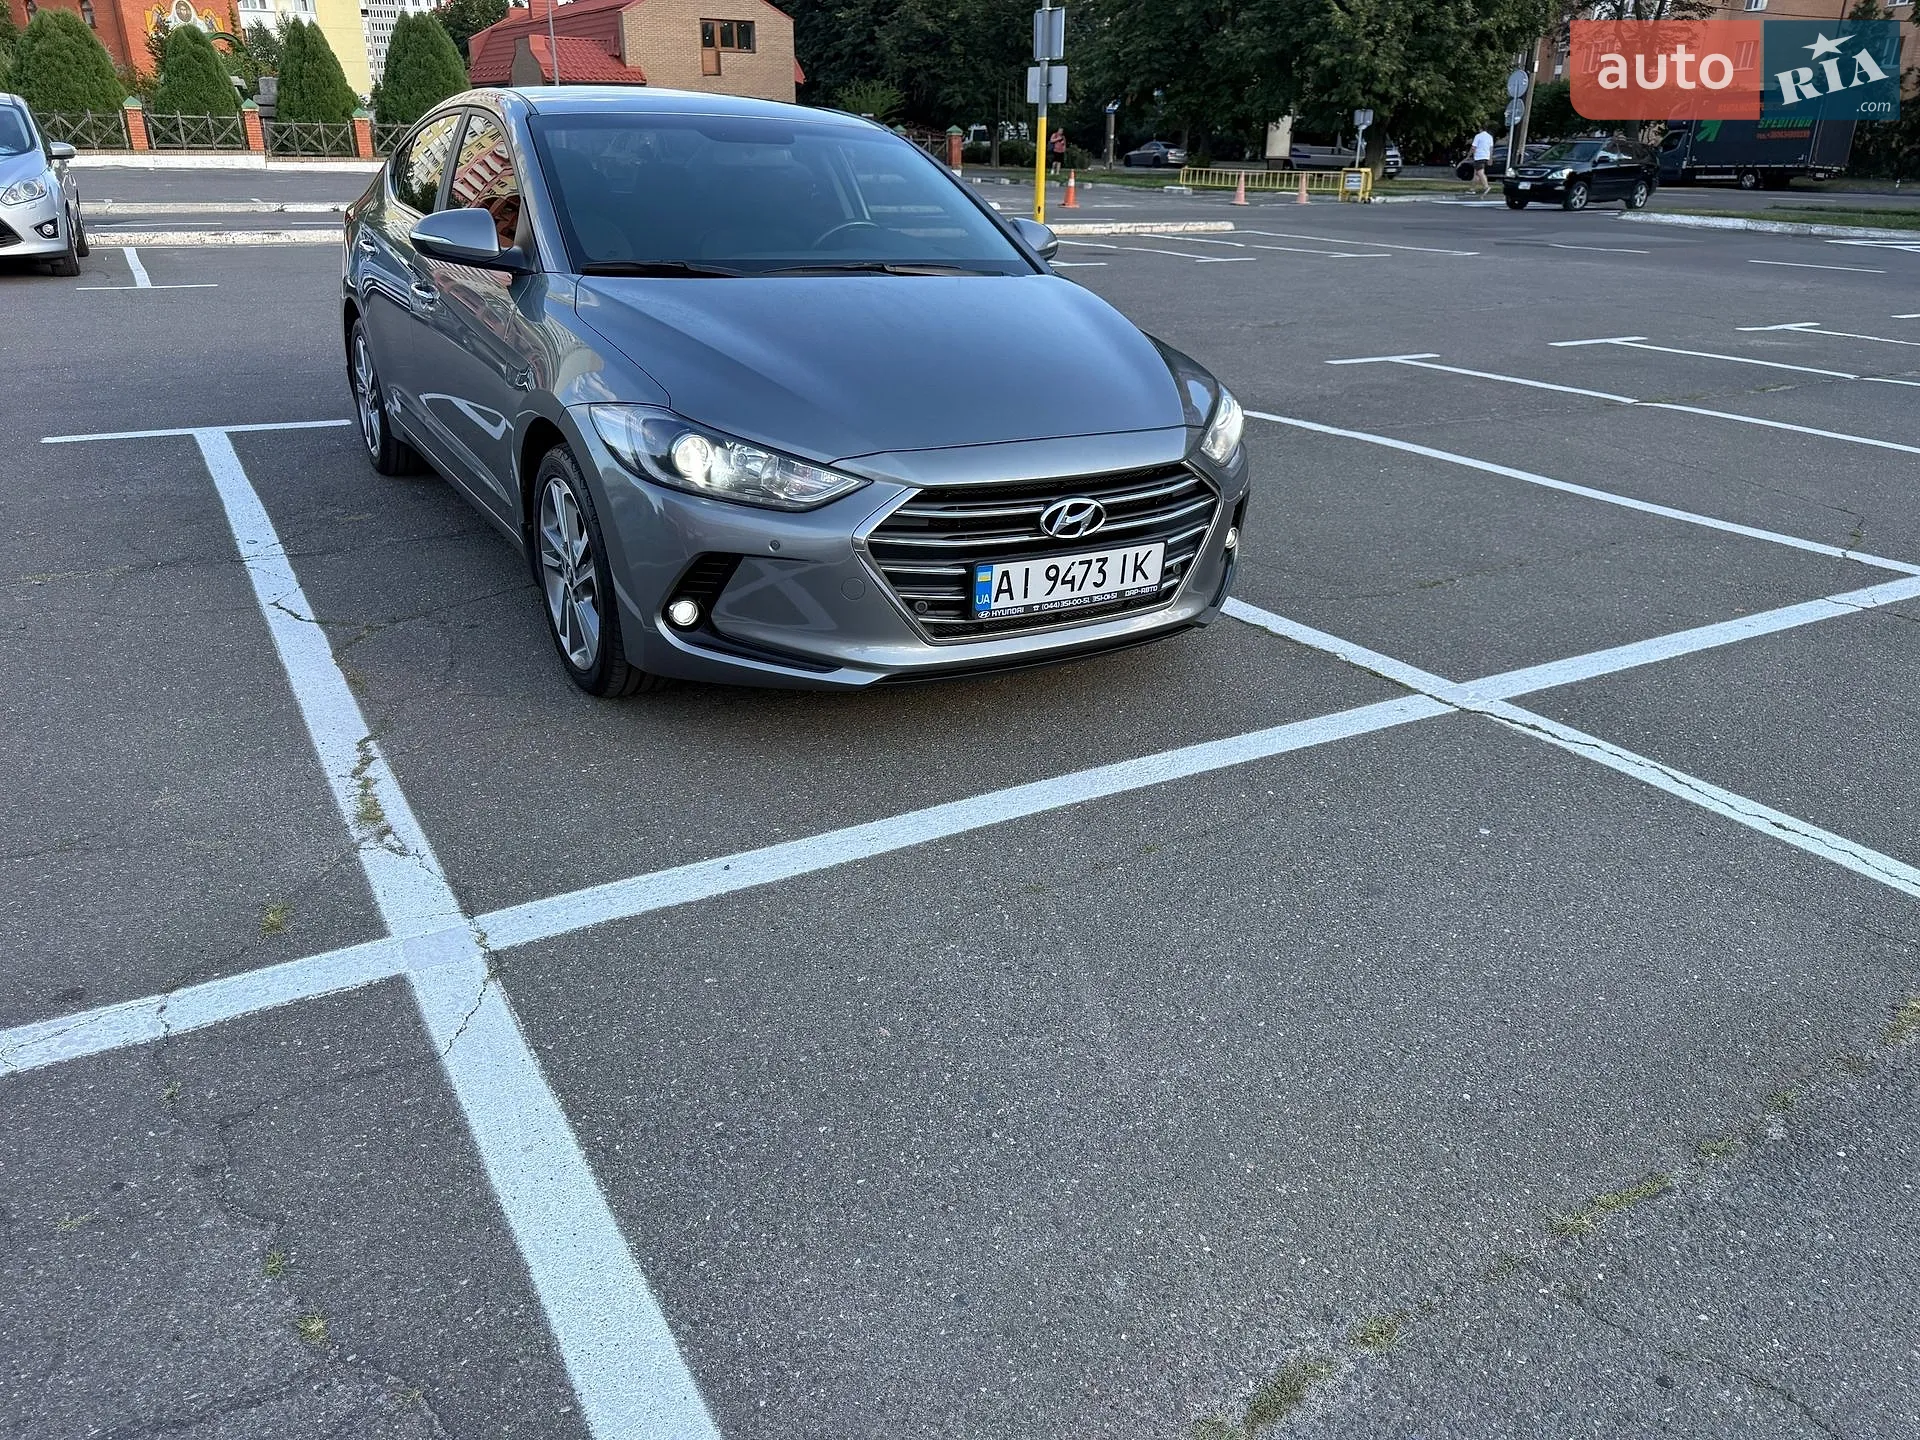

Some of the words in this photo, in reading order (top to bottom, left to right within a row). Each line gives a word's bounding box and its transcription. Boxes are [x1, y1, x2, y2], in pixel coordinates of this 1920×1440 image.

[993, 567, 1030, 603] AI
[1044, 556, 1109, 597] 9473
[1119, 549, 1153, 585] IK
[976, 594, 990, 604] UA
[991, 606, 1025, 617] HYUNDAI
